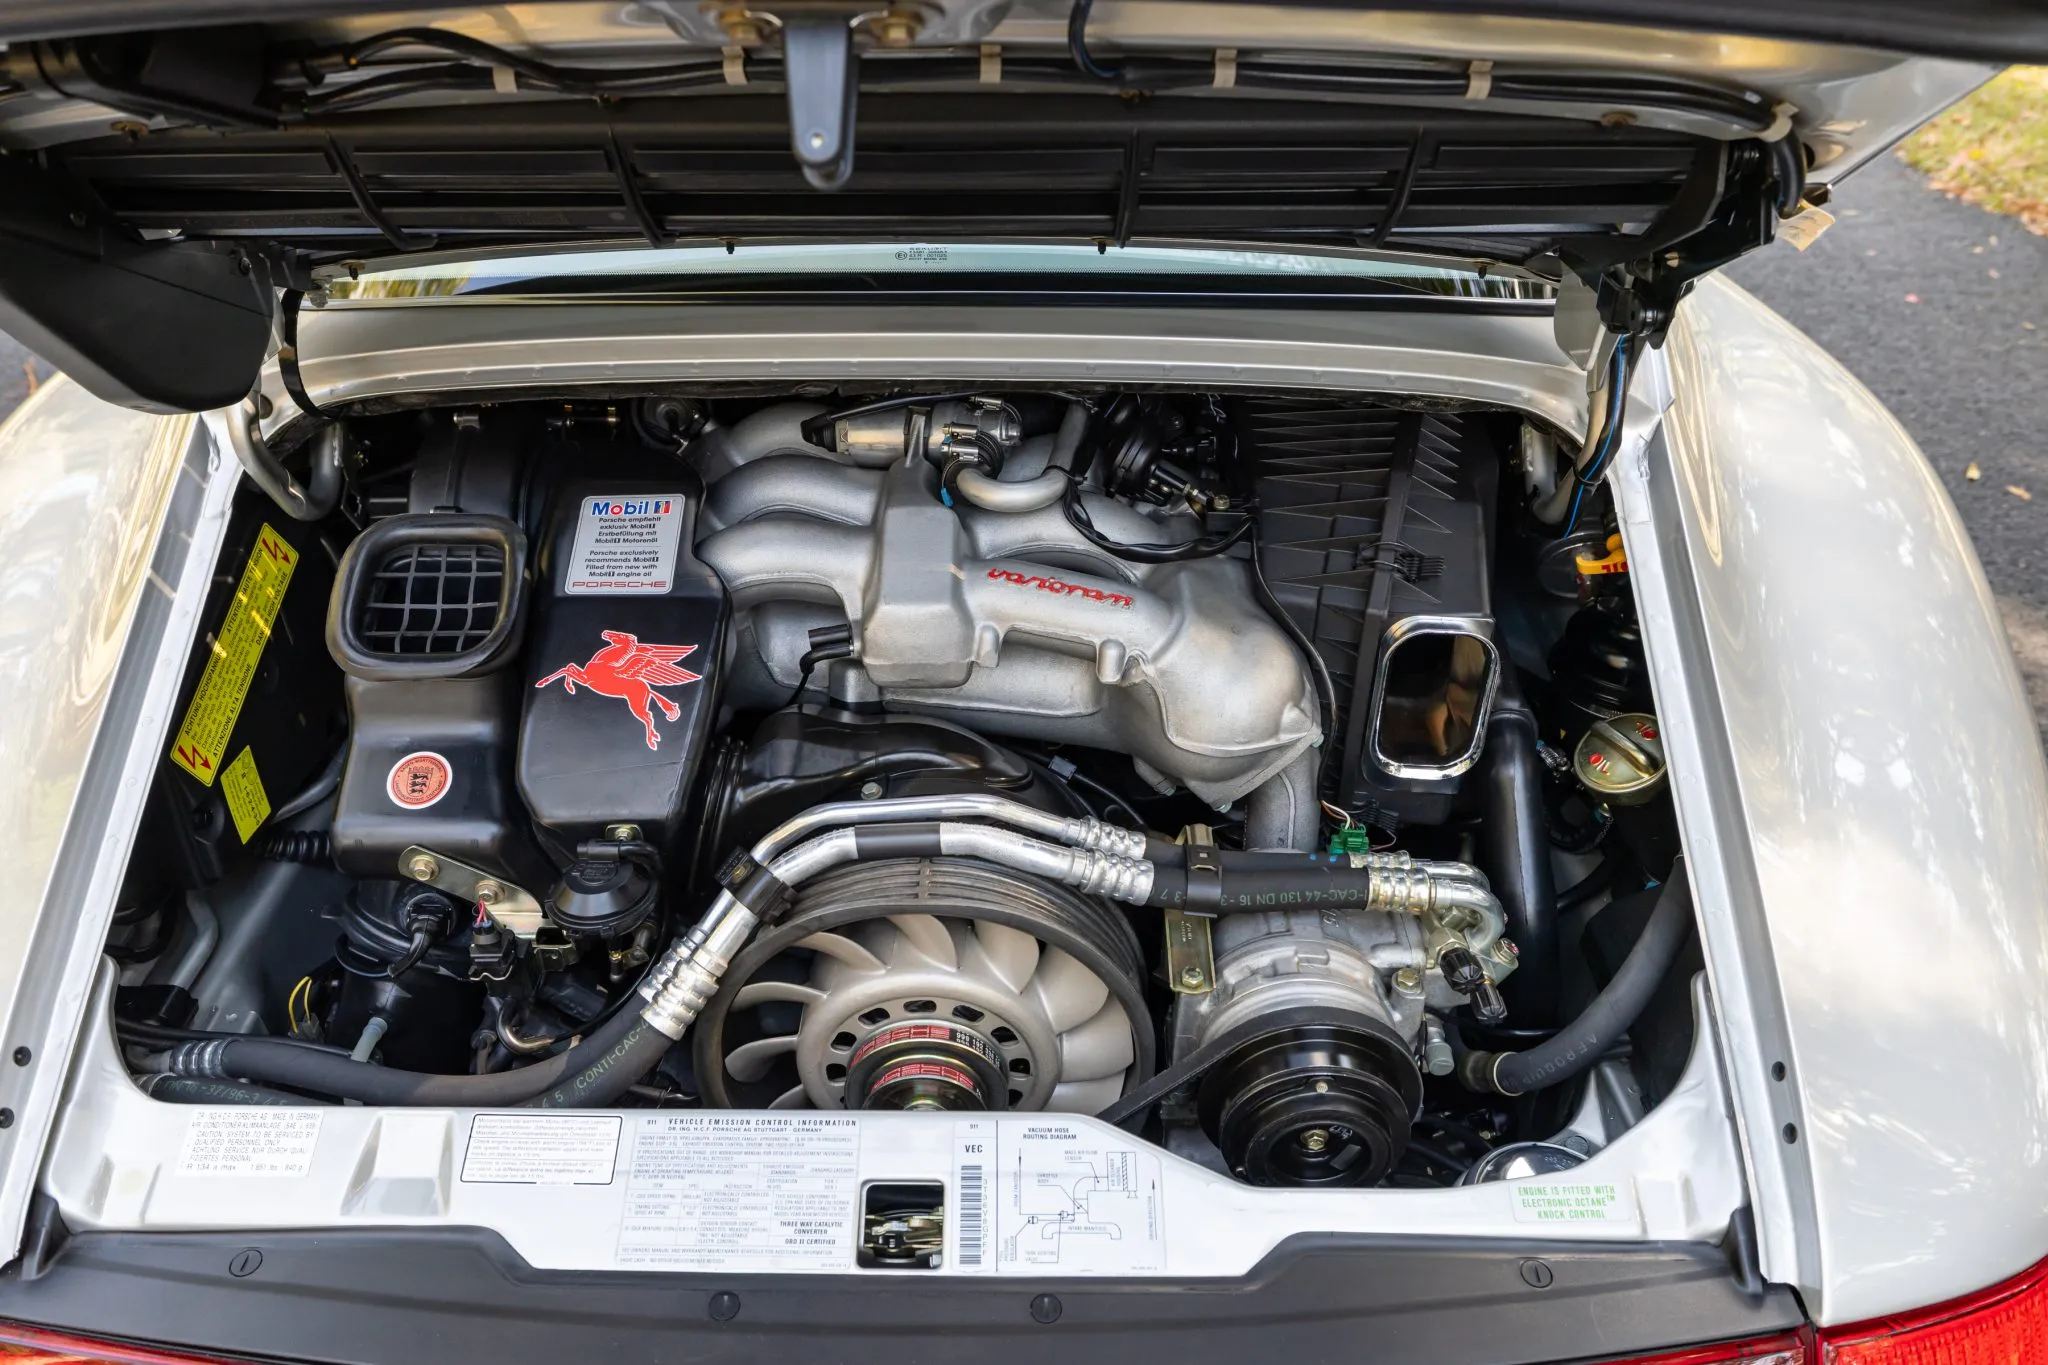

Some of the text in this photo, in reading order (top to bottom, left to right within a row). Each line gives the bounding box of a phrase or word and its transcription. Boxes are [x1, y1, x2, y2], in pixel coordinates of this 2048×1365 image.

[592, 501, 649, 515] Mobil
[628, 516, 661, 524] empfiehlt
[212, 713, 232, 759] ATTENZIONE
[228, 694, 240, 715] ALTA
[235, 661, 252, 696] TENSIONE
[183, 699, 202, 737] ACHTUNG
[1589, 752, 1611, 776] OIL
[1238, 895, 1253, 906] 16
[1256, 894, 1276, 906] DN
[1280, 891, 1302, 904] 130
[668, 1118, 704, 1126] VEHICLE
[708, 1118, 751, 1126] EMISSION
[798, 1119, 857, 1127] INFORMATION
[964, 1144, 984, 1153] VEC
[1518, 1185, 1616, 1196] ENGINE IS FITTED WITH
[1522, 1198, 1572, 1208] ELECTRONIC
[1538, 1210, 1606, 1219] KNOCK CONTROL
